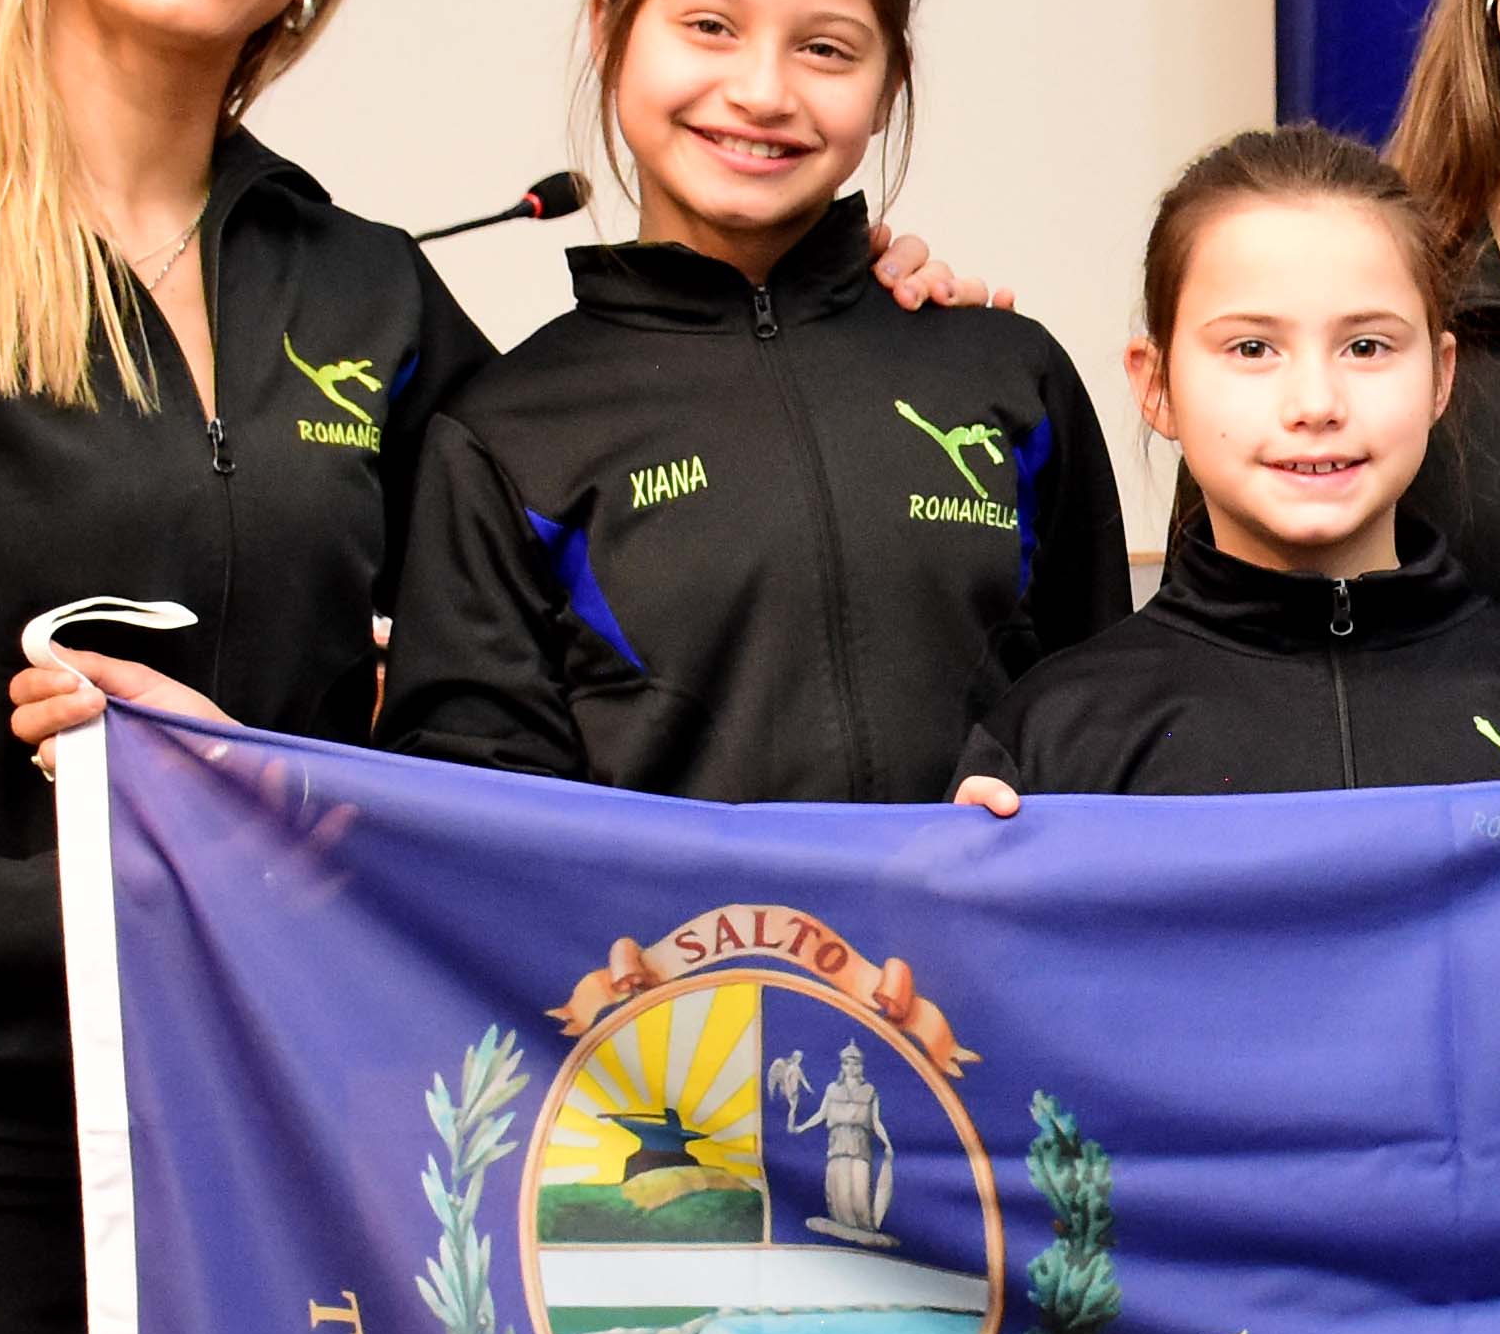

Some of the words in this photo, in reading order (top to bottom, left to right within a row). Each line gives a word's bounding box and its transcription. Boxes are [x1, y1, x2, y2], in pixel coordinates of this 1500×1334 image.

[297, 419, 381, 453] ROMANE
[630, 454, 708, 509] XIANA
[909, 494, 1018, 530] ROMANELLA
[674, 910, 850, 975] SALTO
